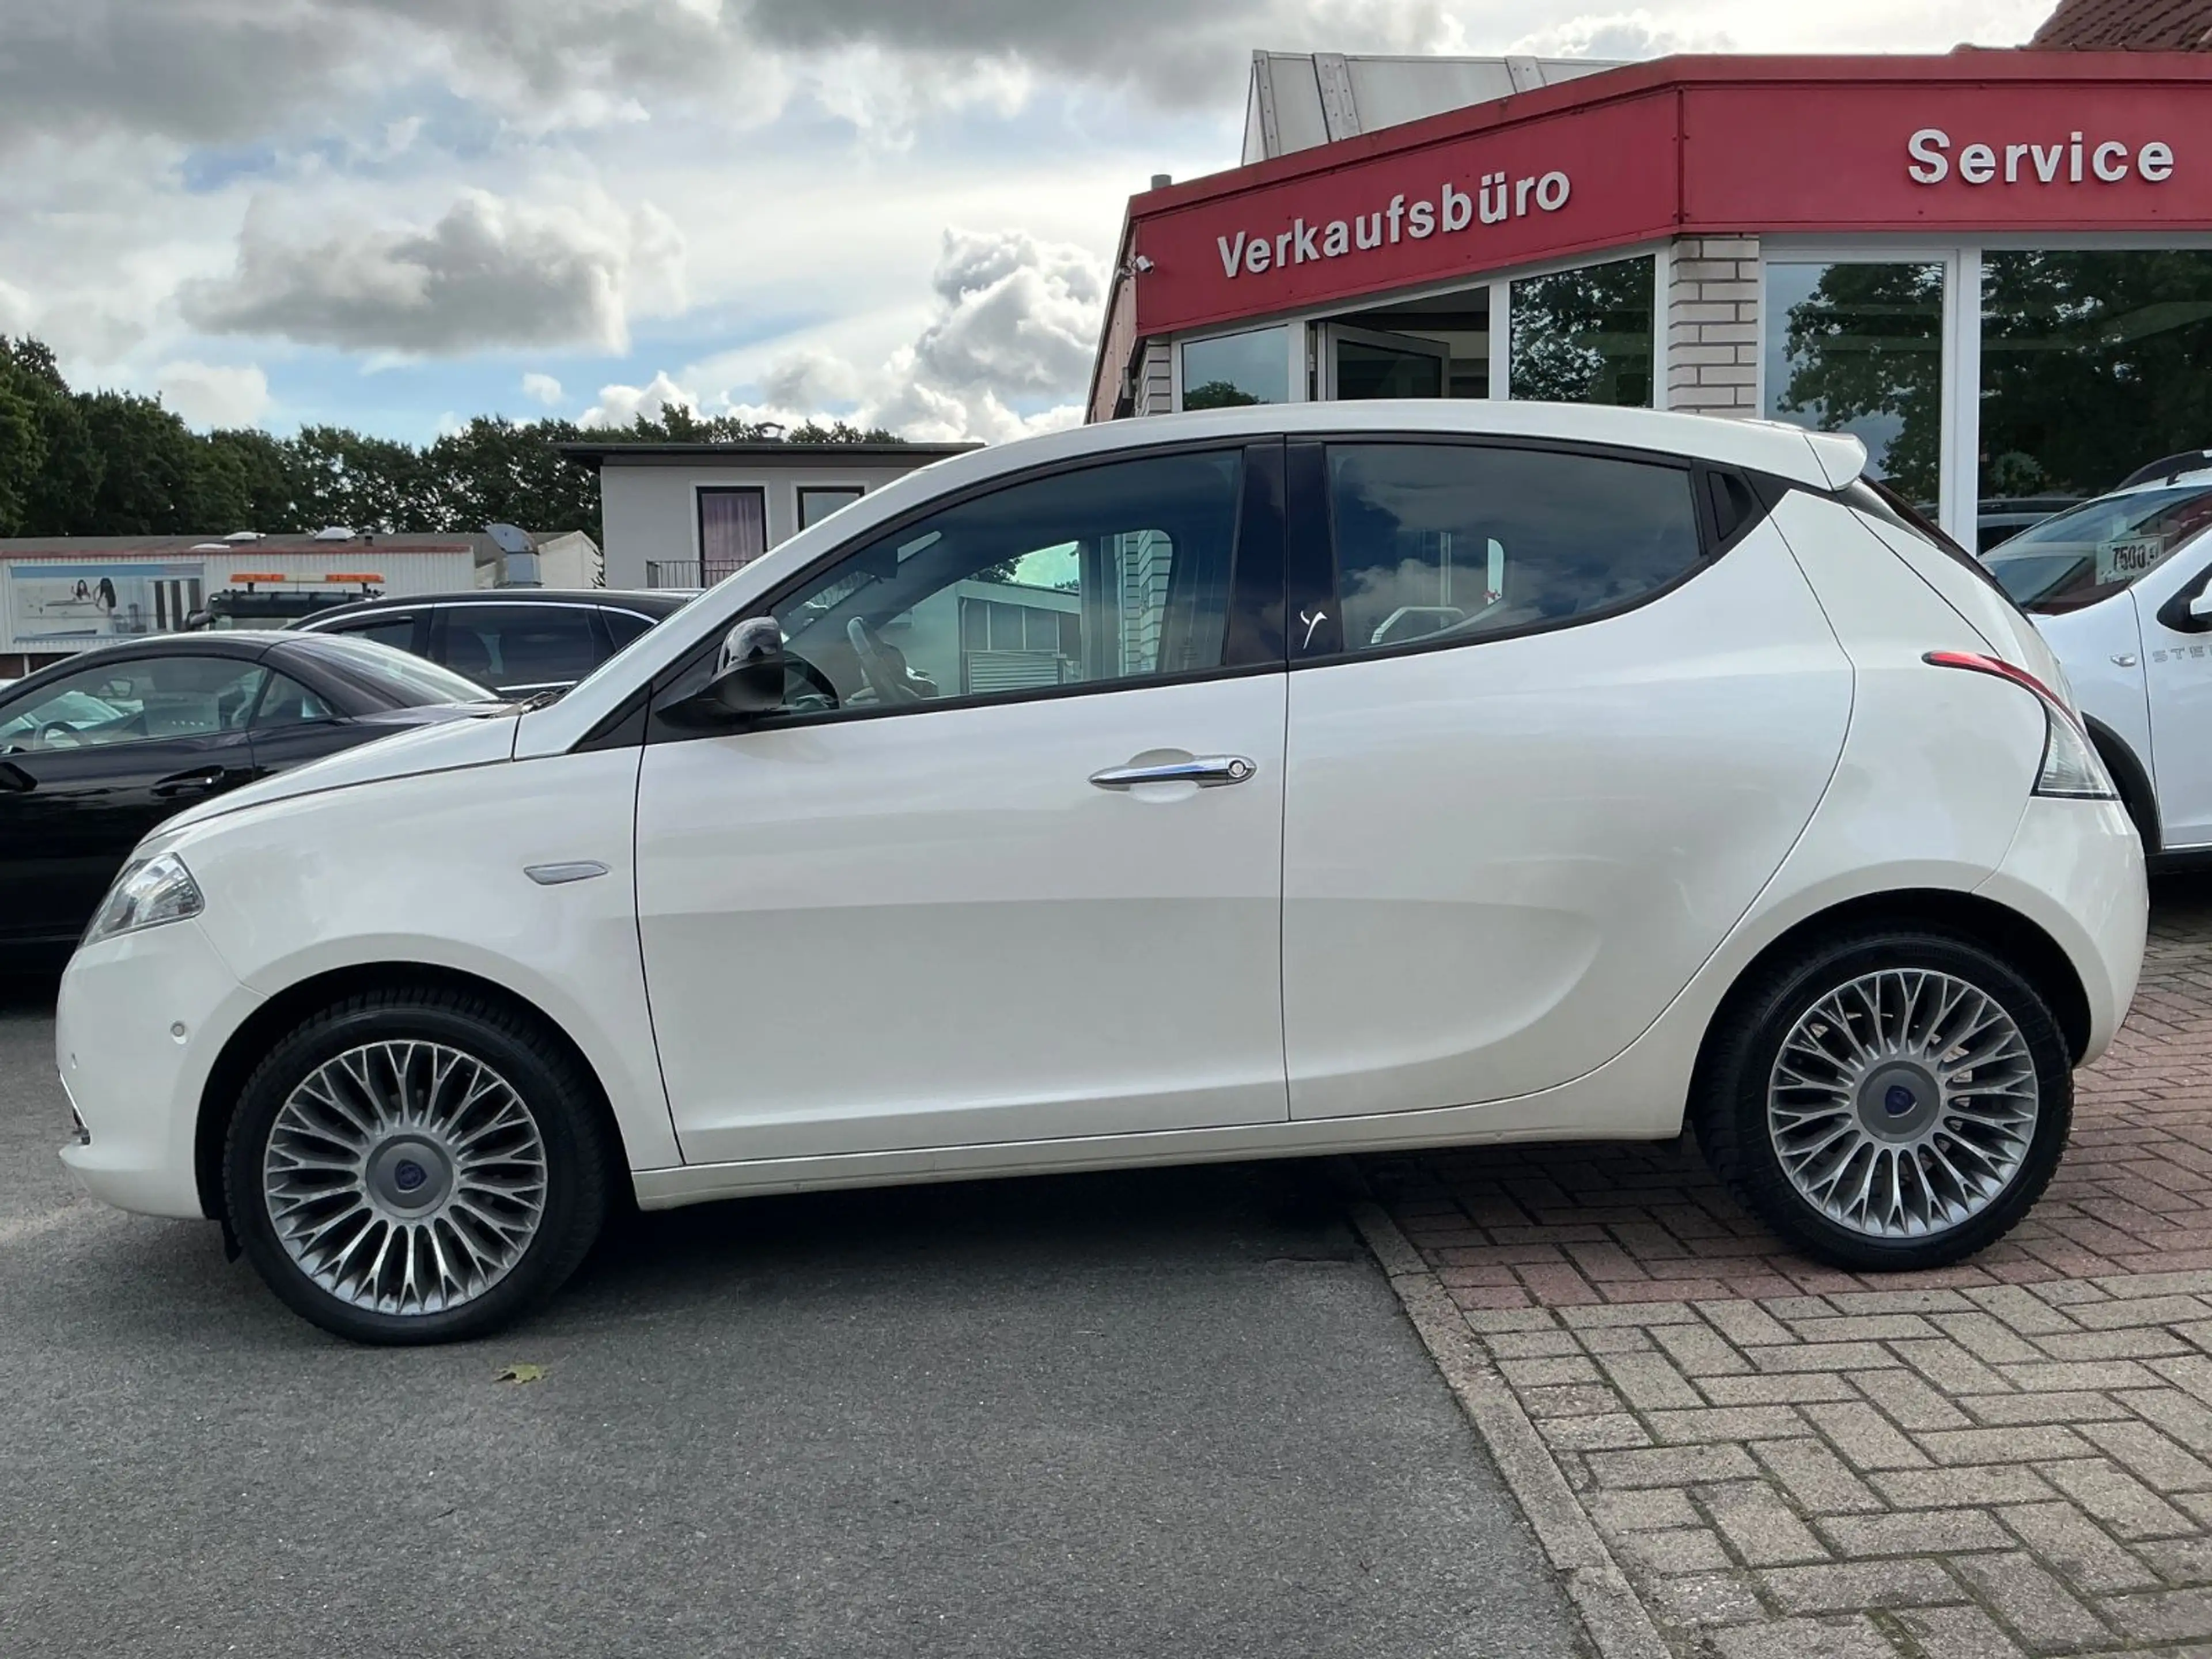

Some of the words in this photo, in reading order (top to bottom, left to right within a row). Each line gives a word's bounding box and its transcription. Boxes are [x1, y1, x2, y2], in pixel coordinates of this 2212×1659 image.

[1908, 128, 2174, 184] Service
[1218, 172, 1570, 278] Verkaufsbüro
[2152, 644, 2212, 662] STE
